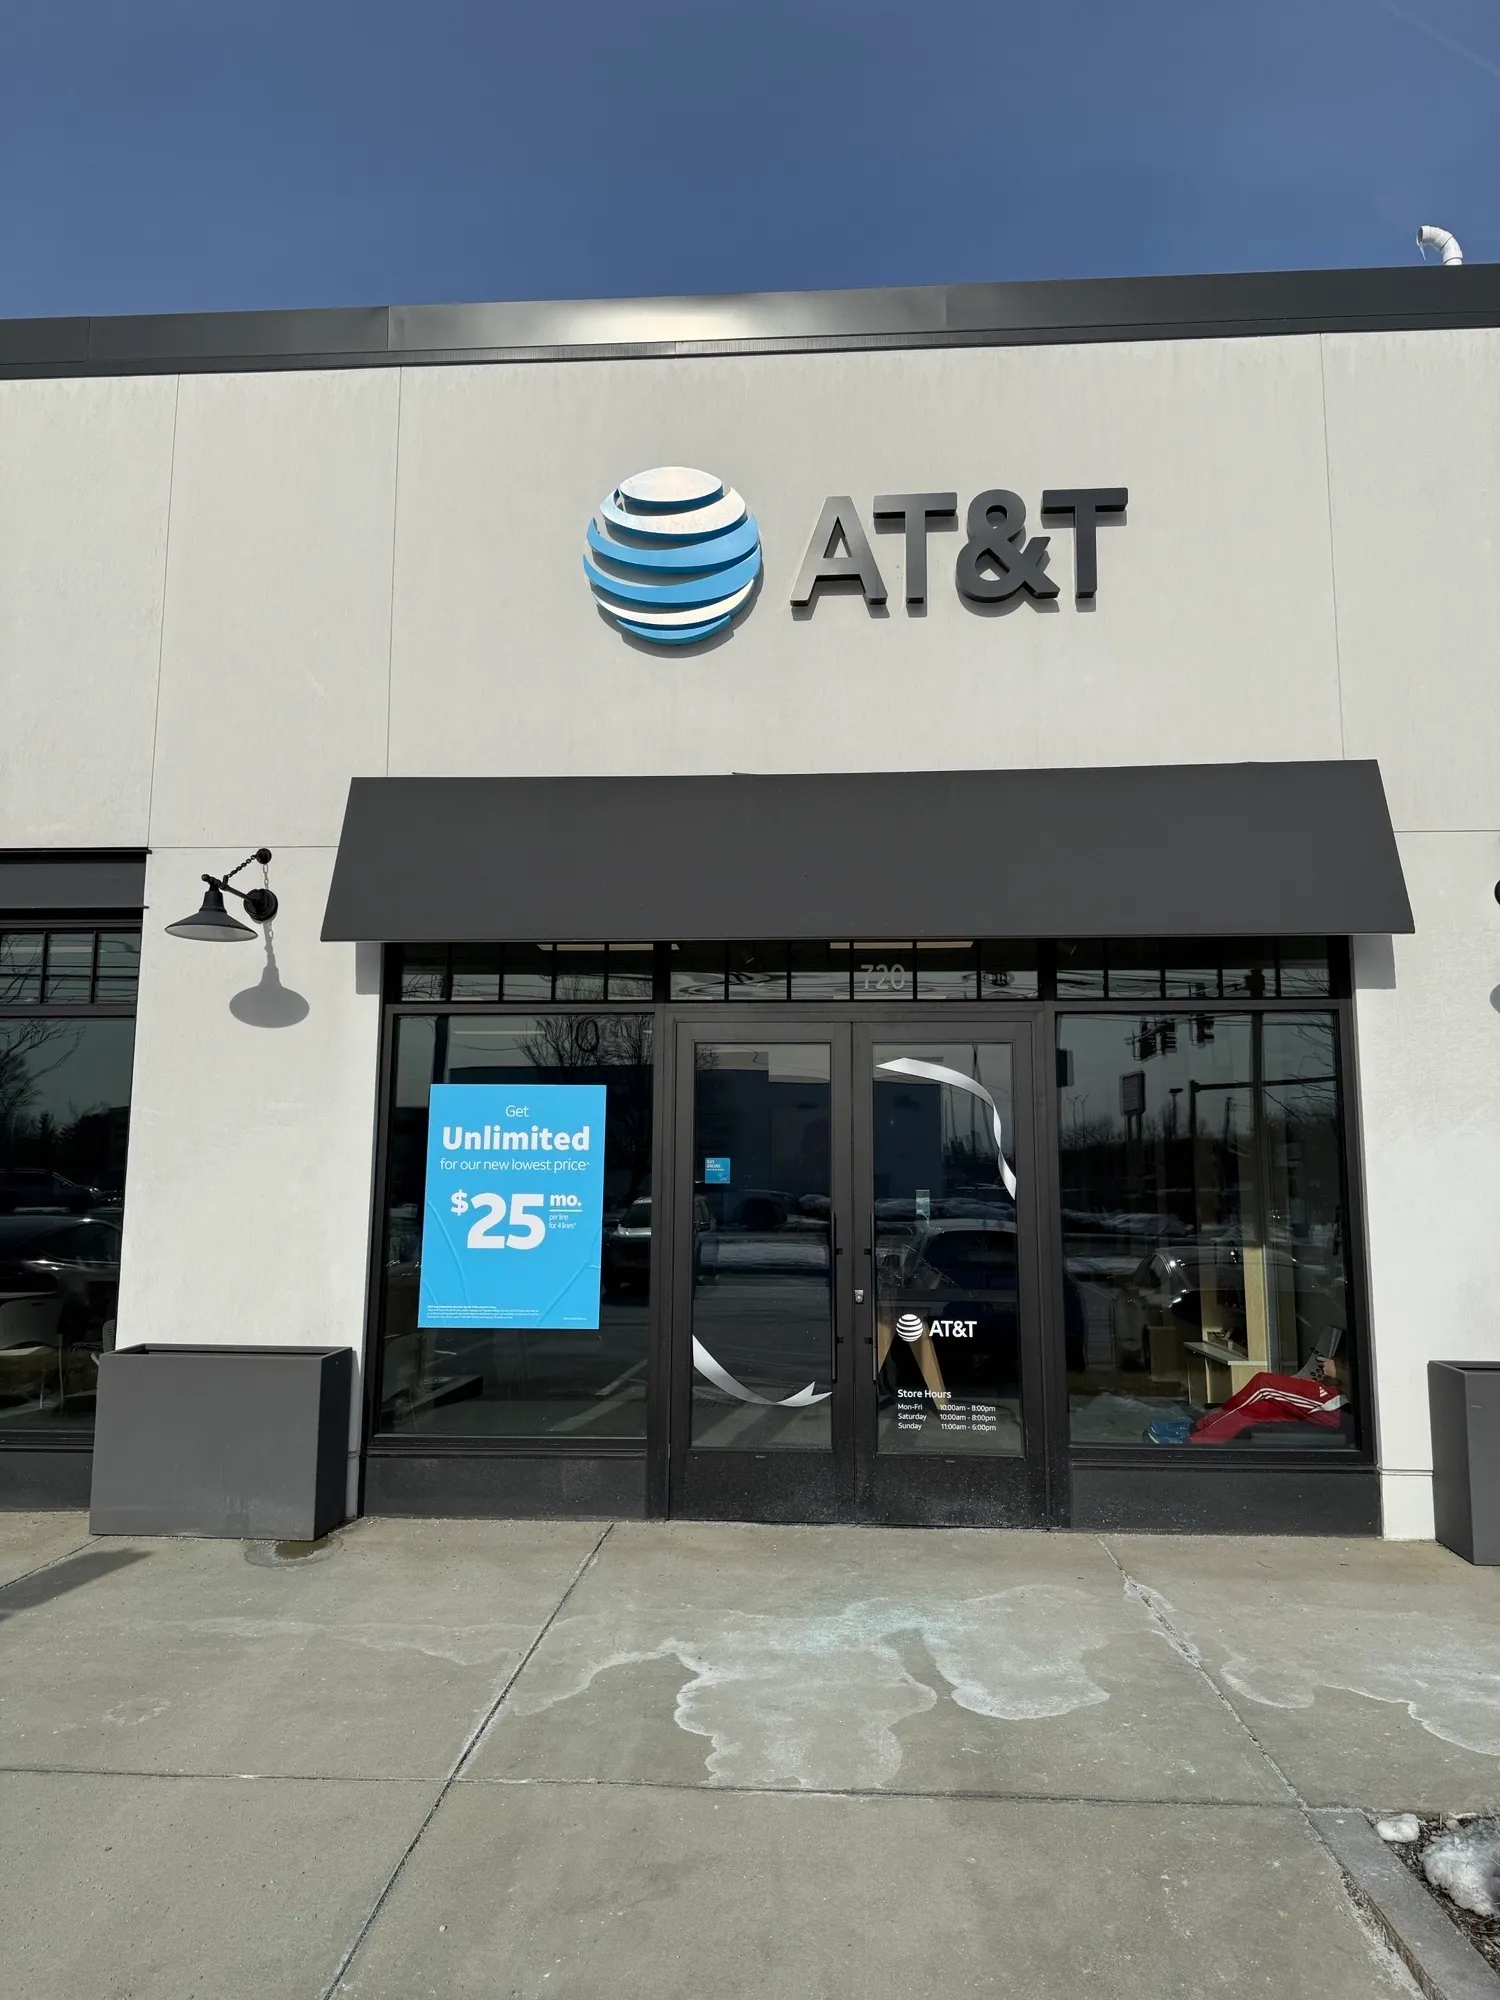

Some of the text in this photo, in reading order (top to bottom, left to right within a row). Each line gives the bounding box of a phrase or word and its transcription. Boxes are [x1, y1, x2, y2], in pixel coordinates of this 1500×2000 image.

[790, 487, 1128, 607] AT&T
[861, 964, 904, 990] 720
[505, 1104, 530, 1117] Get
[442, 1125, 590, 1150] Unlimited
[440, 1158, 456, 1170] for
[460, 1160, 481, 1170] our
[483, 1160, 510, 1170] new
[511, 1158, 551, 1171] lowest
[549, 1194, 582, 1207] mo.
[929, 1320, 977, 1338] AT&T
[897, 1389, 952, 1399] Store Hours
[897, 1403, 923, 1411] Mon-Fri
[939, 1404, 966, 1412] 10:00am
[971, 1404, 996, 1413] 8:00pm
[898, 1413, 927, 1421] Saturday
[971, 1414, 997, 1422] 8:00pm
[898, 1422, 922, 1430] Sunday
[971, 1423, 997, 1432] 6:00pm
